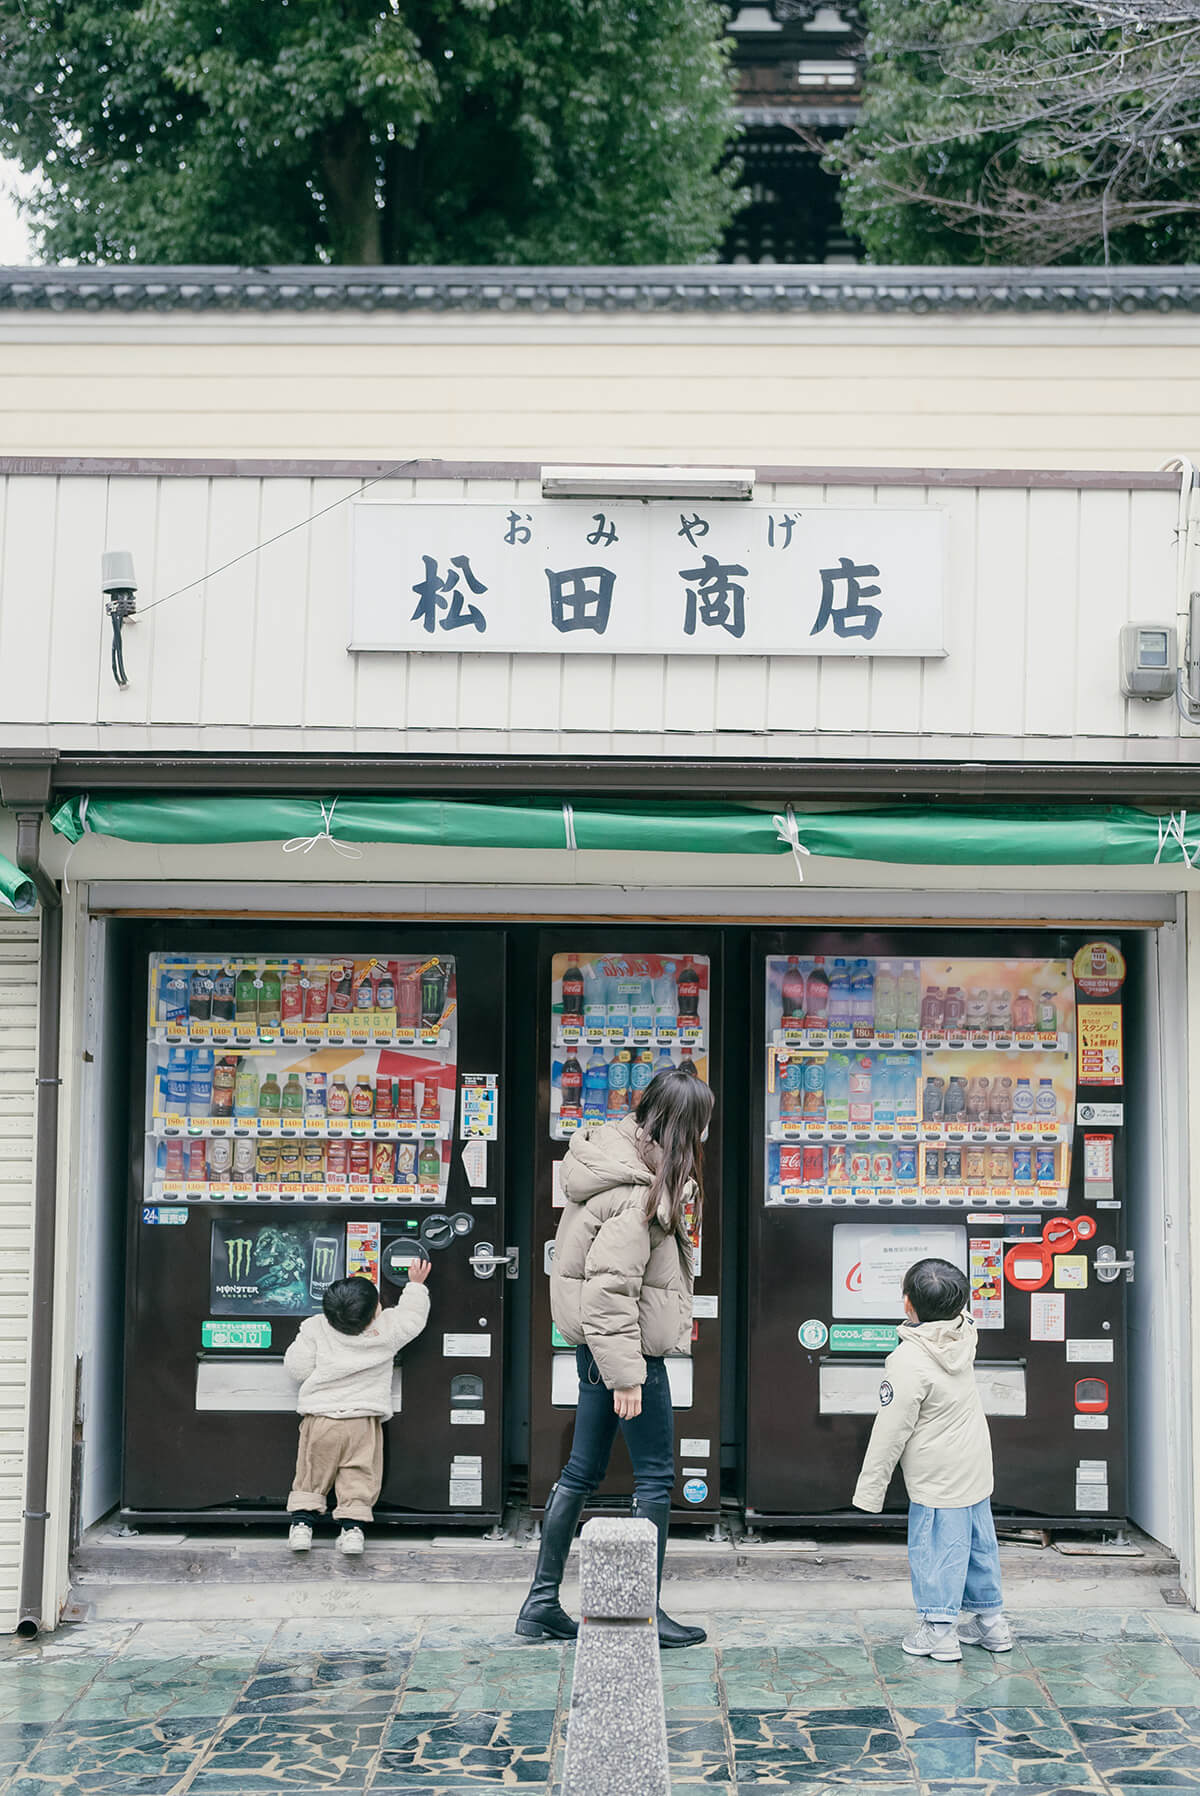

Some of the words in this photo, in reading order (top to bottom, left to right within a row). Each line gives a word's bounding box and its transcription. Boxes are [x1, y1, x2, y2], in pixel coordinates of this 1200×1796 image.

[504, 510, 801, 549] おみやげ
[411, 555, 882, 640] 松田商店
[333, 1015, 392, 1025] ENERGY
[216, 1285, 259, 1295] MONSTER
